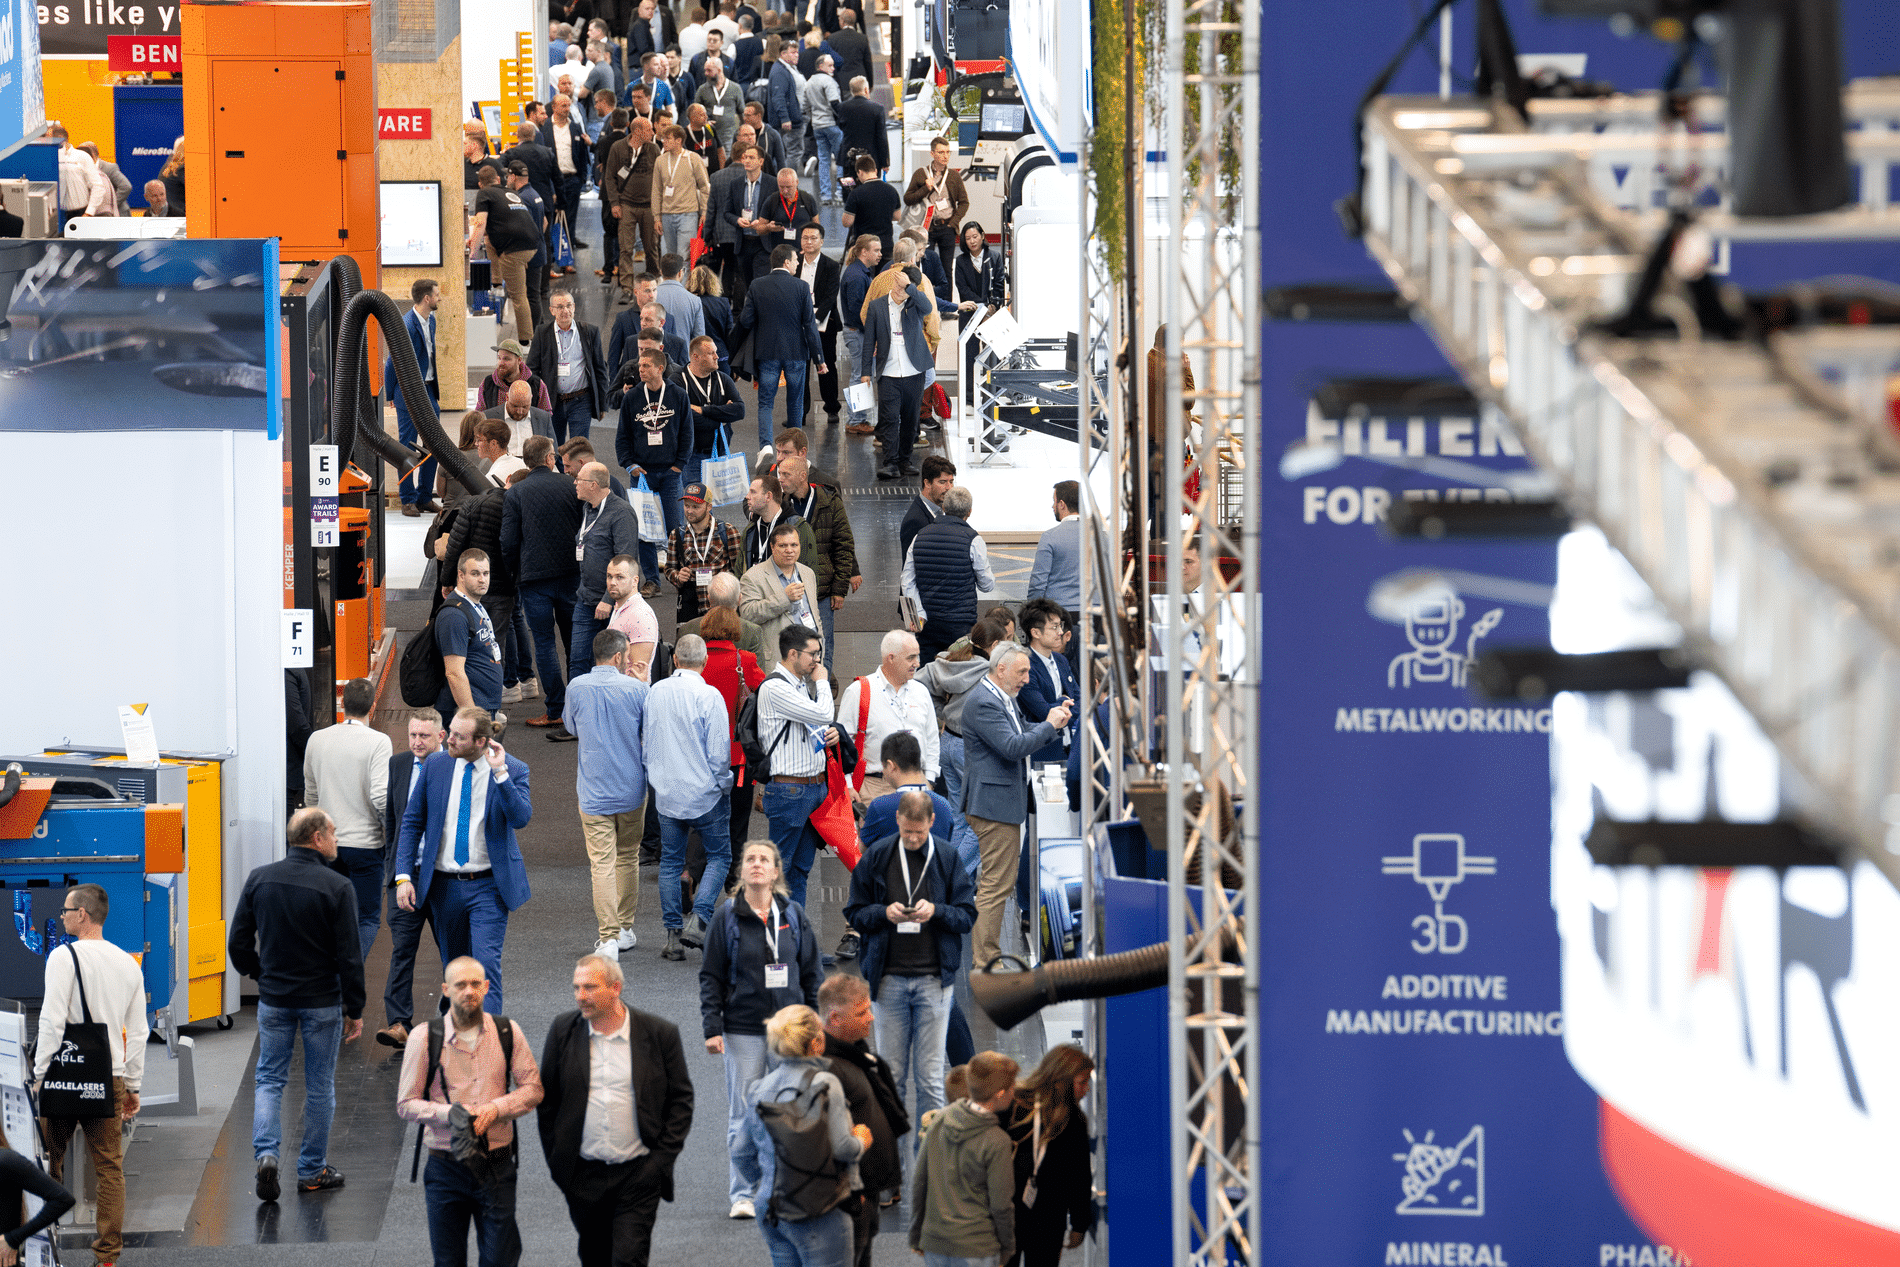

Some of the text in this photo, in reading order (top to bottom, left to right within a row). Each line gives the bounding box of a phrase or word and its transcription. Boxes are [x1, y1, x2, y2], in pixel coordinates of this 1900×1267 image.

[84, 0, 145, 25] like
[157, 6, 181, 32] y
[132, 44, 182, 63] BEN
[320, 456, 329, 472] E
[318, 477, 331, 486] 90
[1302, 486, 1392, 525] FOR
[325, 531, 331, 544] 1
[285, 544, 295, 590] KEMPER
[292, 622, 302, 640] F
[292, 646, 302, 656] 71
[1334, 707, 1553, 733] METALWORKING
[1411, 914, 1468, 954] 3D
[1382, 975, 1508, 1000] ADDITIVE
[1326, 1009, 1564, 1036] MANUFACTURING
[52, 1054, 85, 1064] AGLE
[44, 1081, 105, 1091] EAGLELASERS
[80, 1090, 106, 1099] .COM
[1385, 1243, 1508, 1267] MINERAL
